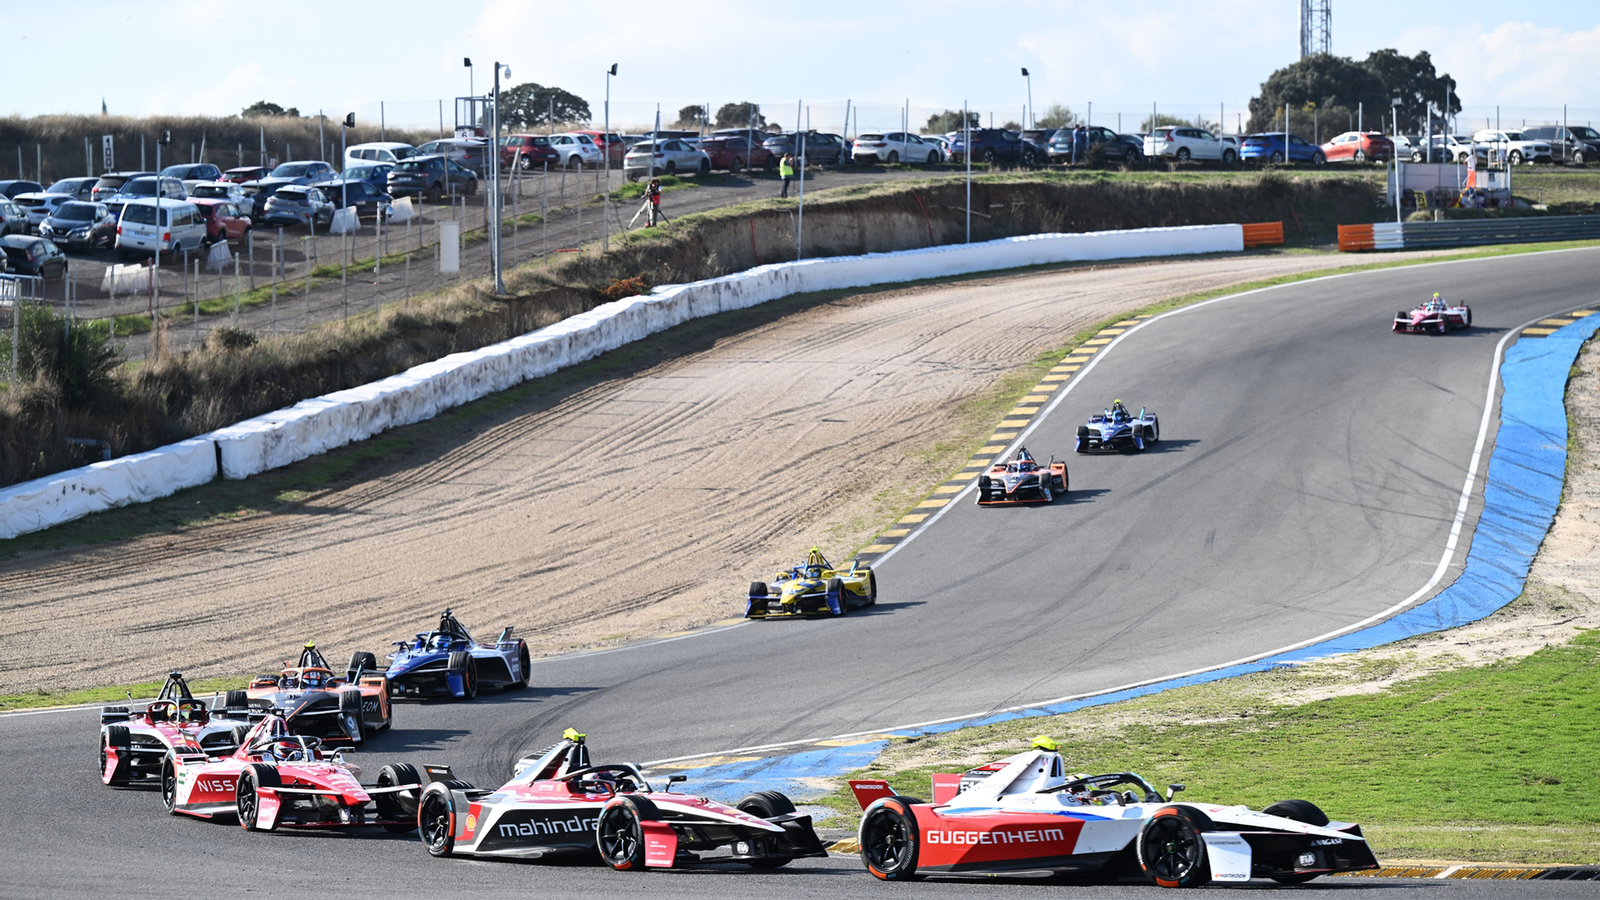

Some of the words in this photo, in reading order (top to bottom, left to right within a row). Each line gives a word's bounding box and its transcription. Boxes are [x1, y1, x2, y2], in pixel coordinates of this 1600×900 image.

[362, 701, 379, 712] EOM
[197, 780, 236, 792] NISS
[499, 816, 600, 837] mahindra
[927, 829, 1065, 845] GUGGENHEIM
[1300, 855, 1314, 864] FIA
